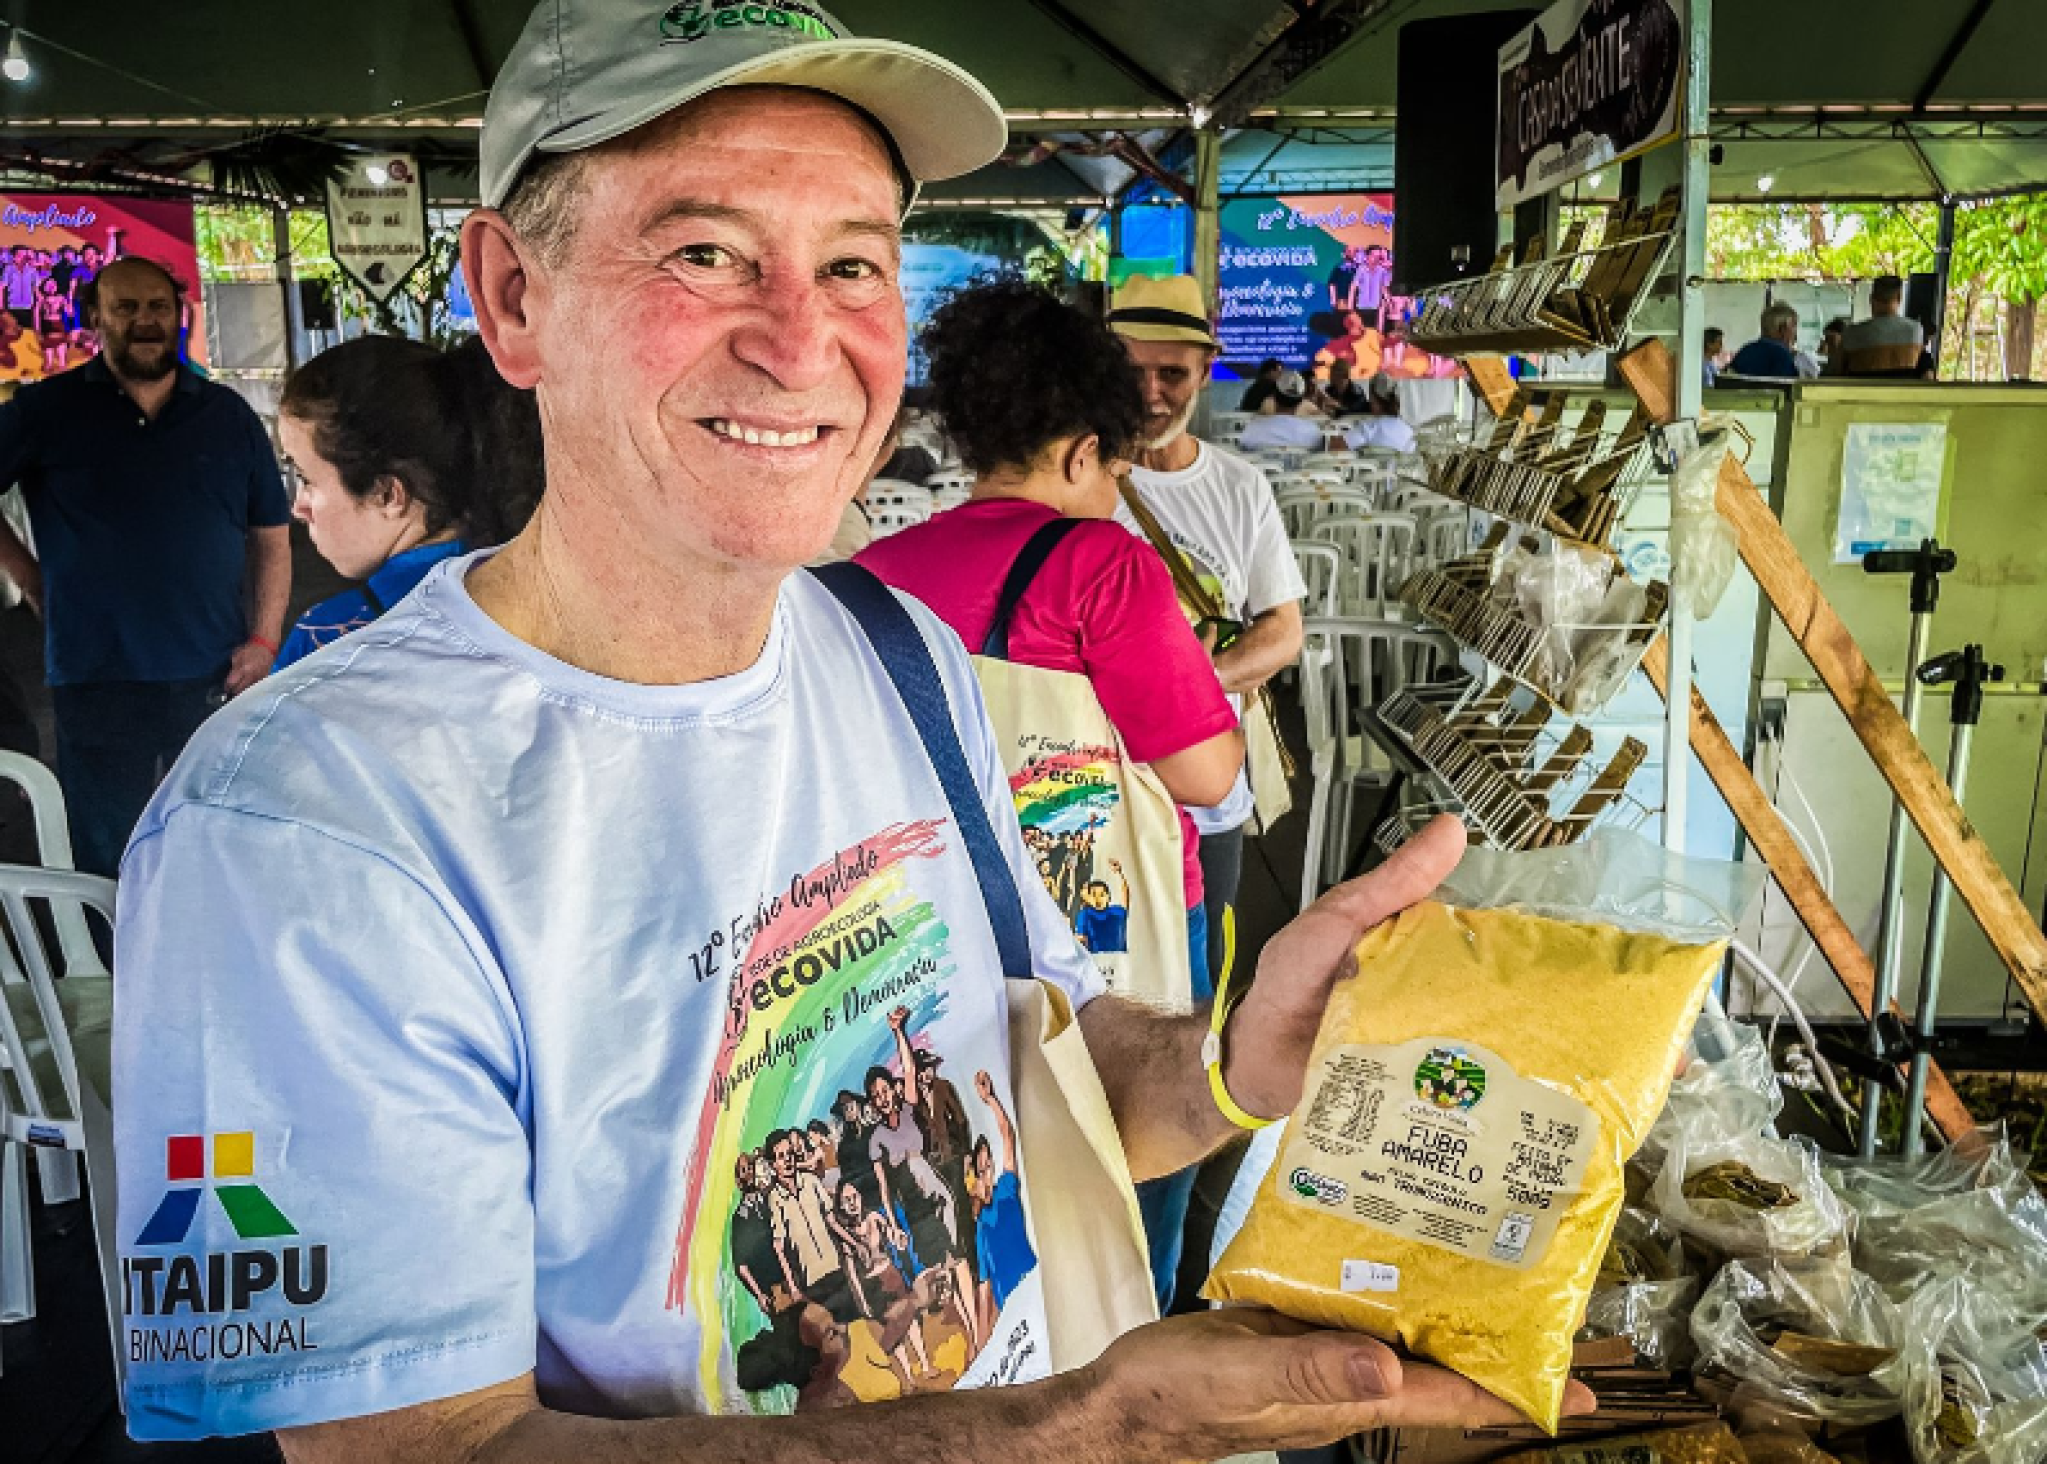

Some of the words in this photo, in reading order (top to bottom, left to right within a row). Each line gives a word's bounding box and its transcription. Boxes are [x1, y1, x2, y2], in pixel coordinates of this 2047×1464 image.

[2, 203, 96, 234] Ampliado
[688, 929, 725, 983] 12º
[791, 845, 880, 911] Ampliado
[1382, 1139, 1484, 1184] AMARELO
[123, 1245, 328, 1316] ITAIPU
[131, 1317, 318, 1362] BINACIONAL
